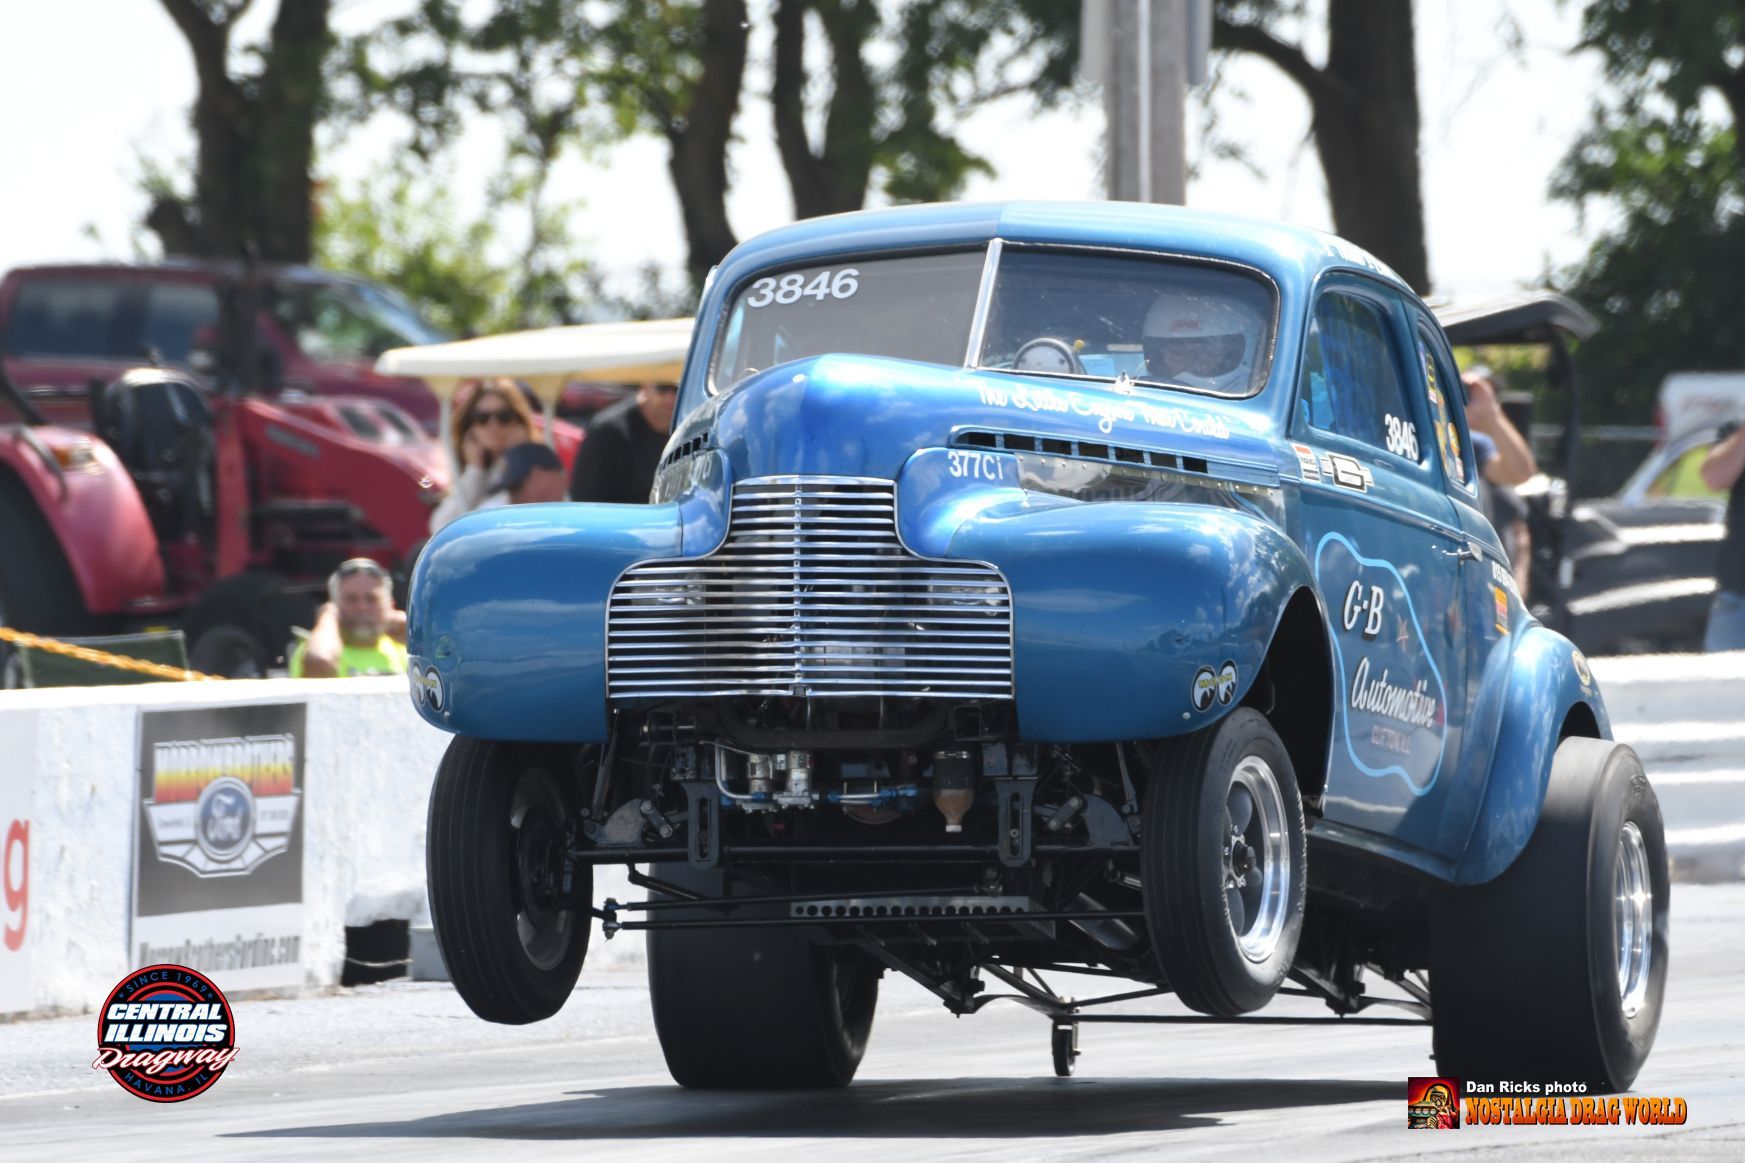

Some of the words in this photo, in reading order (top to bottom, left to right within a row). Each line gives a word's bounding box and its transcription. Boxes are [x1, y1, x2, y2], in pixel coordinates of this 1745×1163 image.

[747, 268, 859, 308] 3846
[1384, 413, 1419, 461] 3846
[1351, 656, 1436, 729] Automotive
